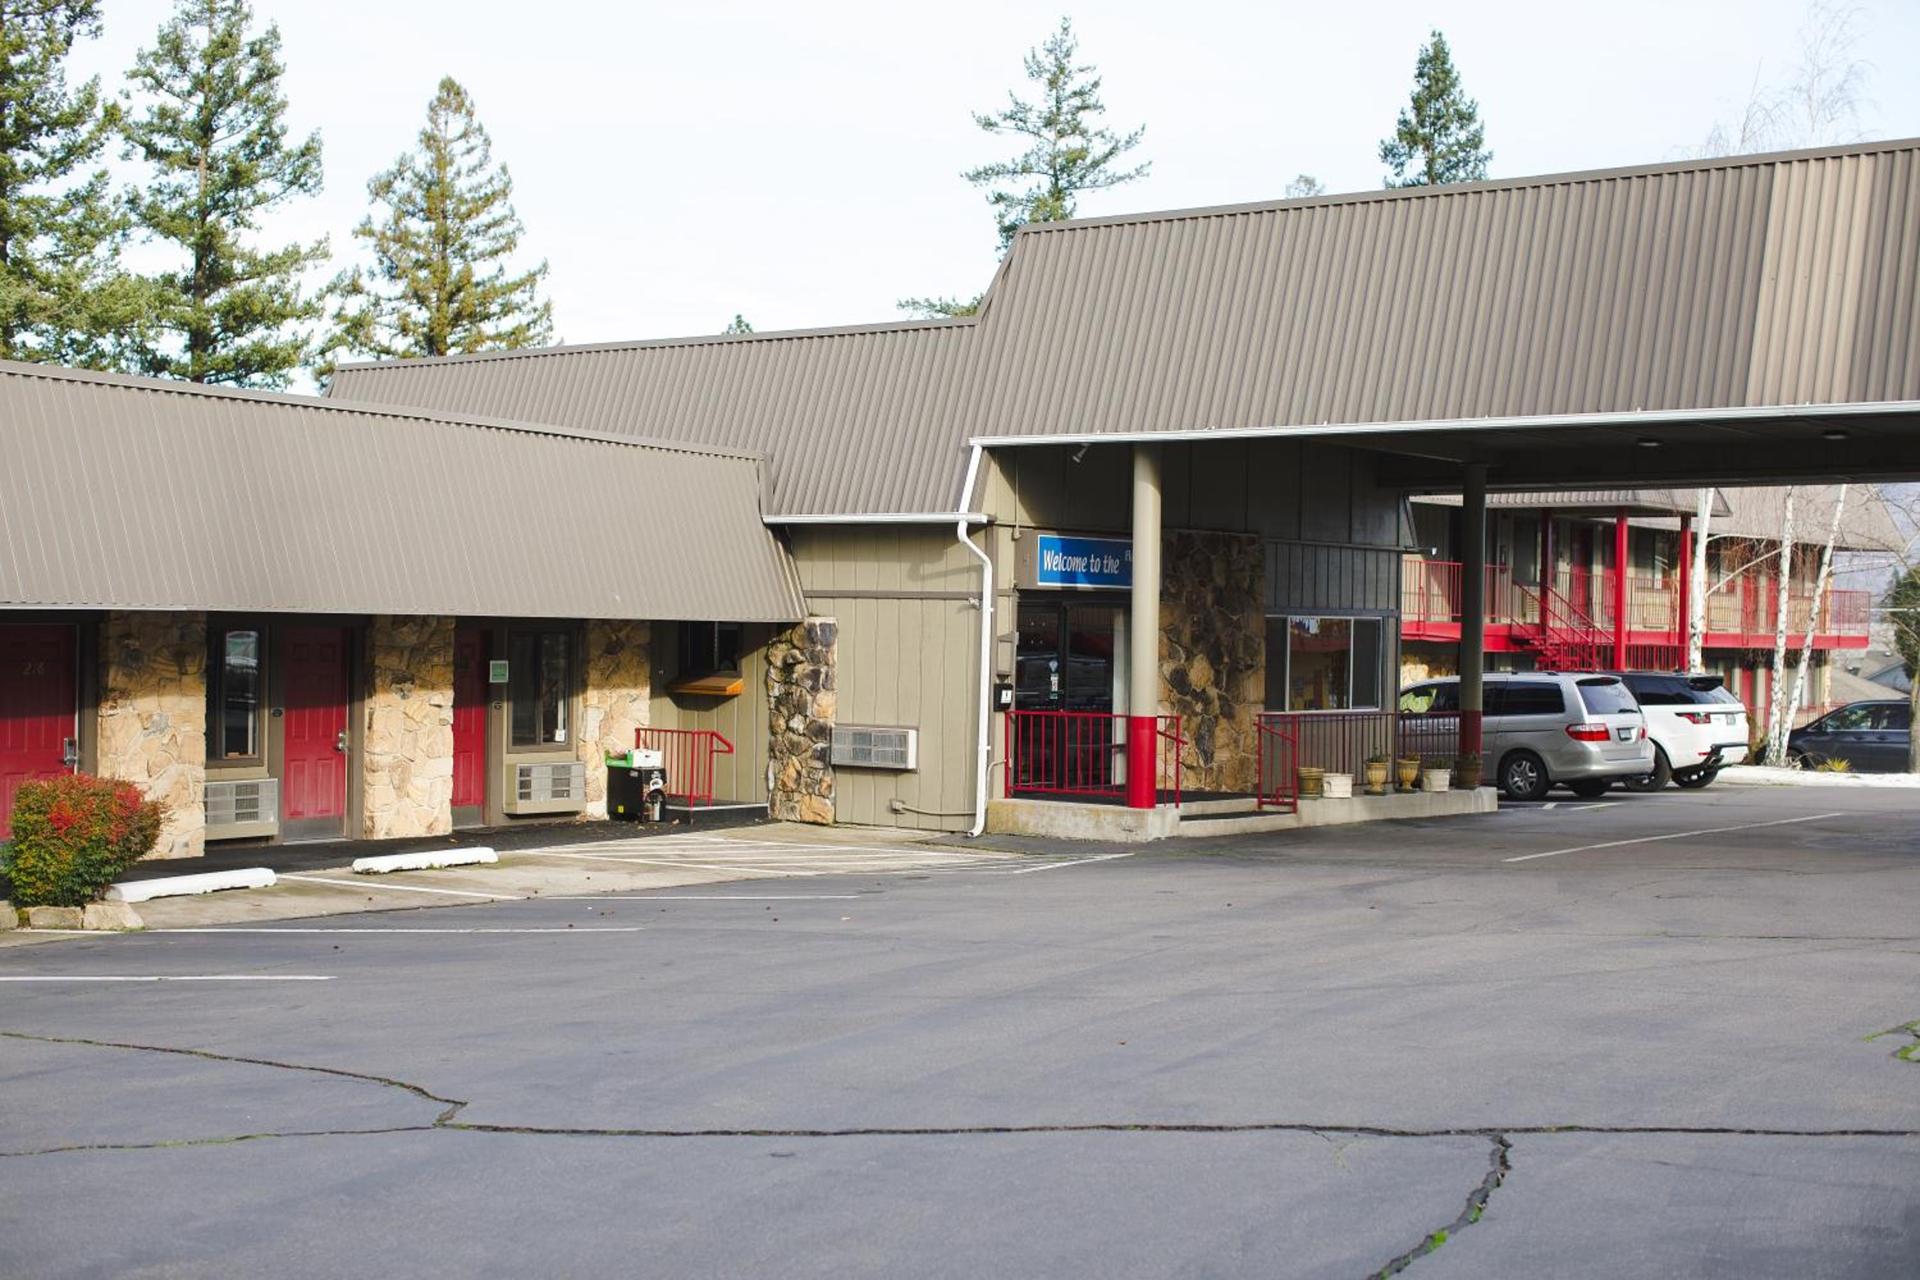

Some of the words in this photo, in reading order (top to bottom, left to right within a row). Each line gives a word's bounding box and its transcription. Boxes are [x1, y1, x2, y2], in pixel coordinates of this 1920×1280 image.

[1043, 549, 1087, 572] Welcome
[1089, 554, 1101, 573] to
[1103, 555, 1120, 574] the
